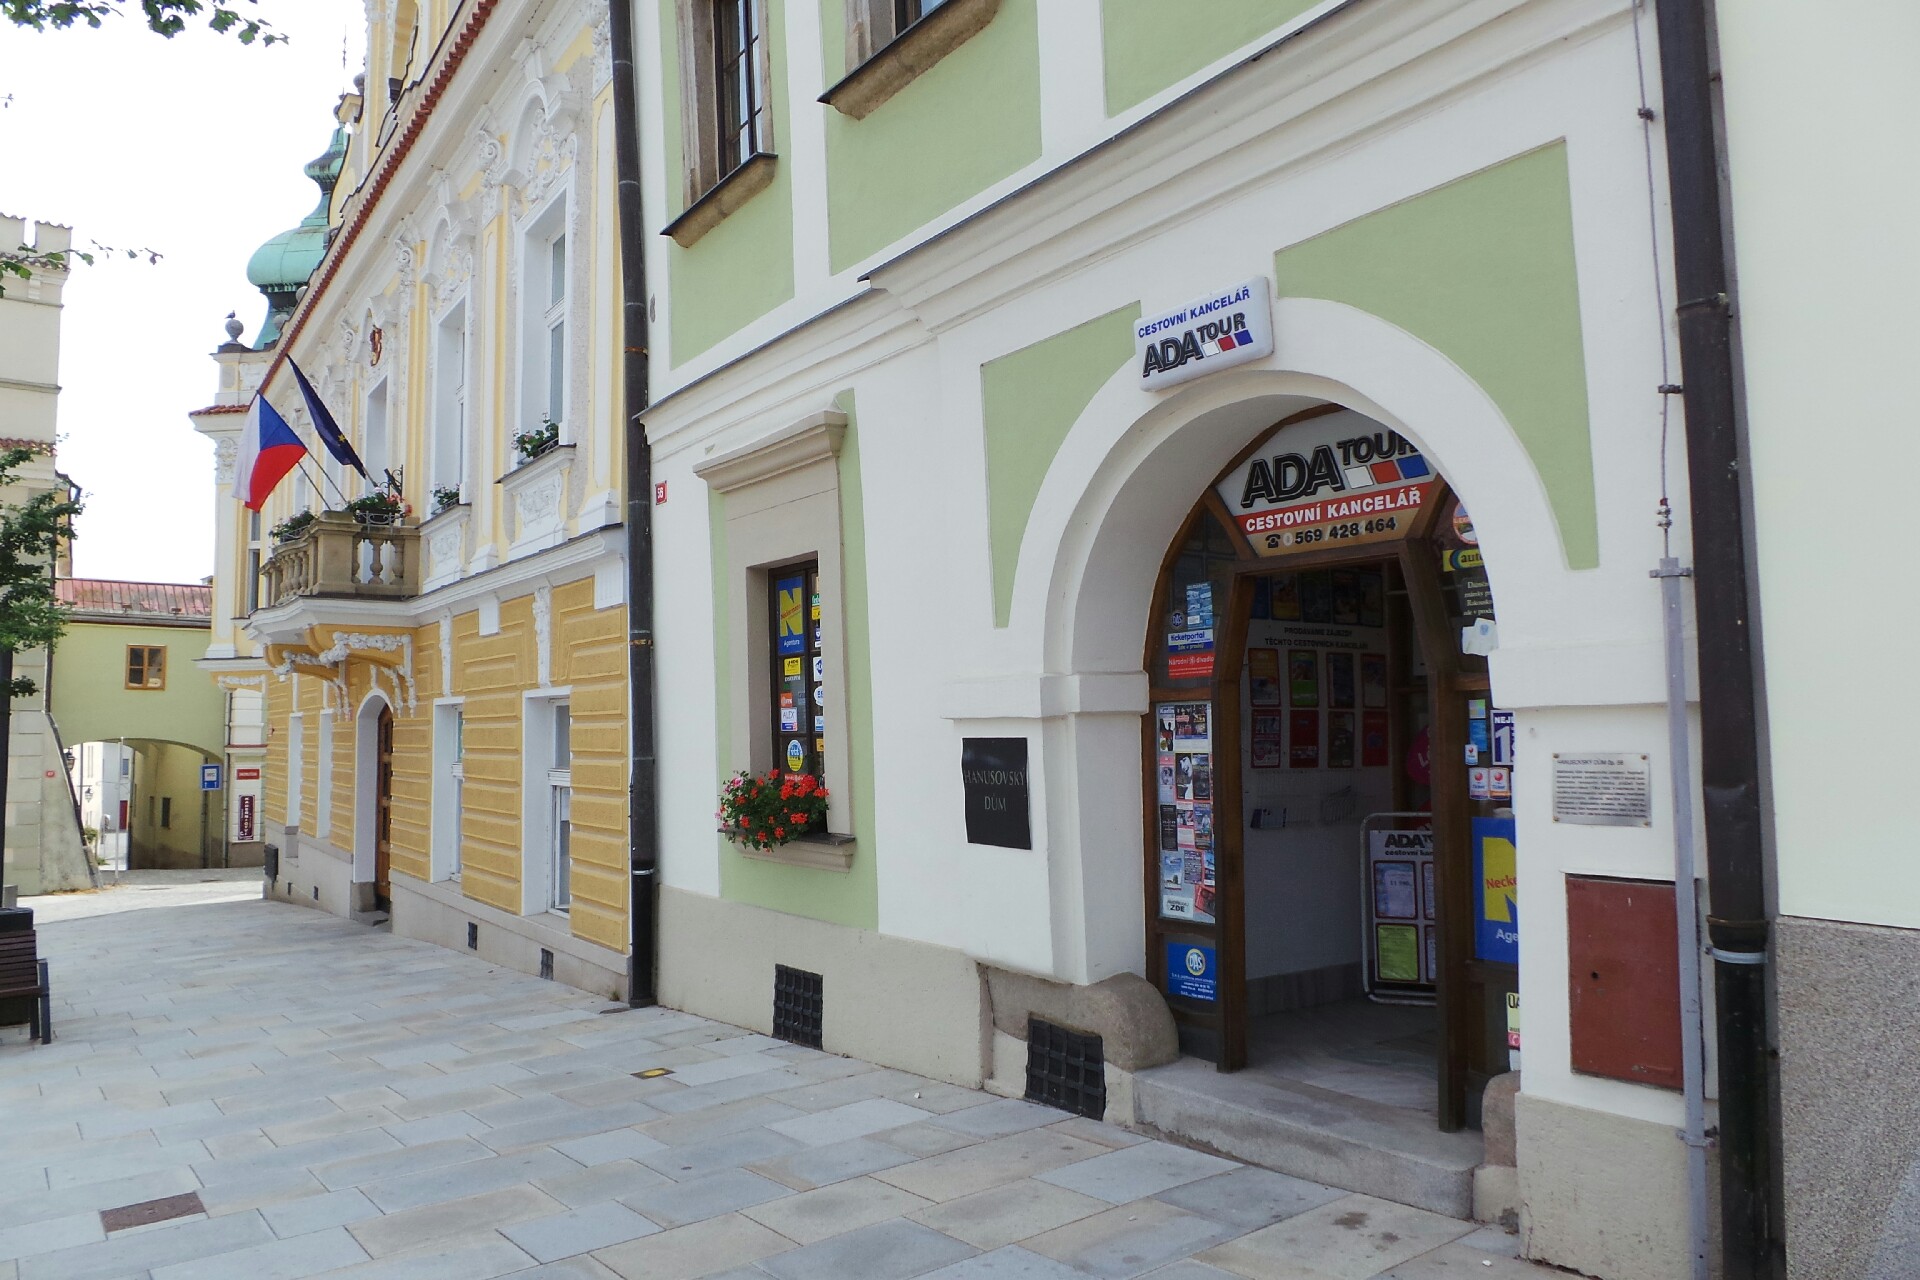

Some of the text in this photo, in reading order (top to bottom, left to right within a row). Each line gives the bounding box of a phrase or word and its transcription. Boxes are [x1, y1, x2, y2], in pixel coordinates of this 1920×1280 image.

[1138, 285, 1250, 338] CESTOVNÍ KANCELÁŘ
[1143, 312, 1246, 378] ADA TOUR
[1240, 445, 1345, 509] ADA
[1246, 487, 1421, 532] CESTOVNÍ KANCELÁŘ
[1385, 834, 1426, 848] ADA
[1170, 904, 1185, 913] ZDE
